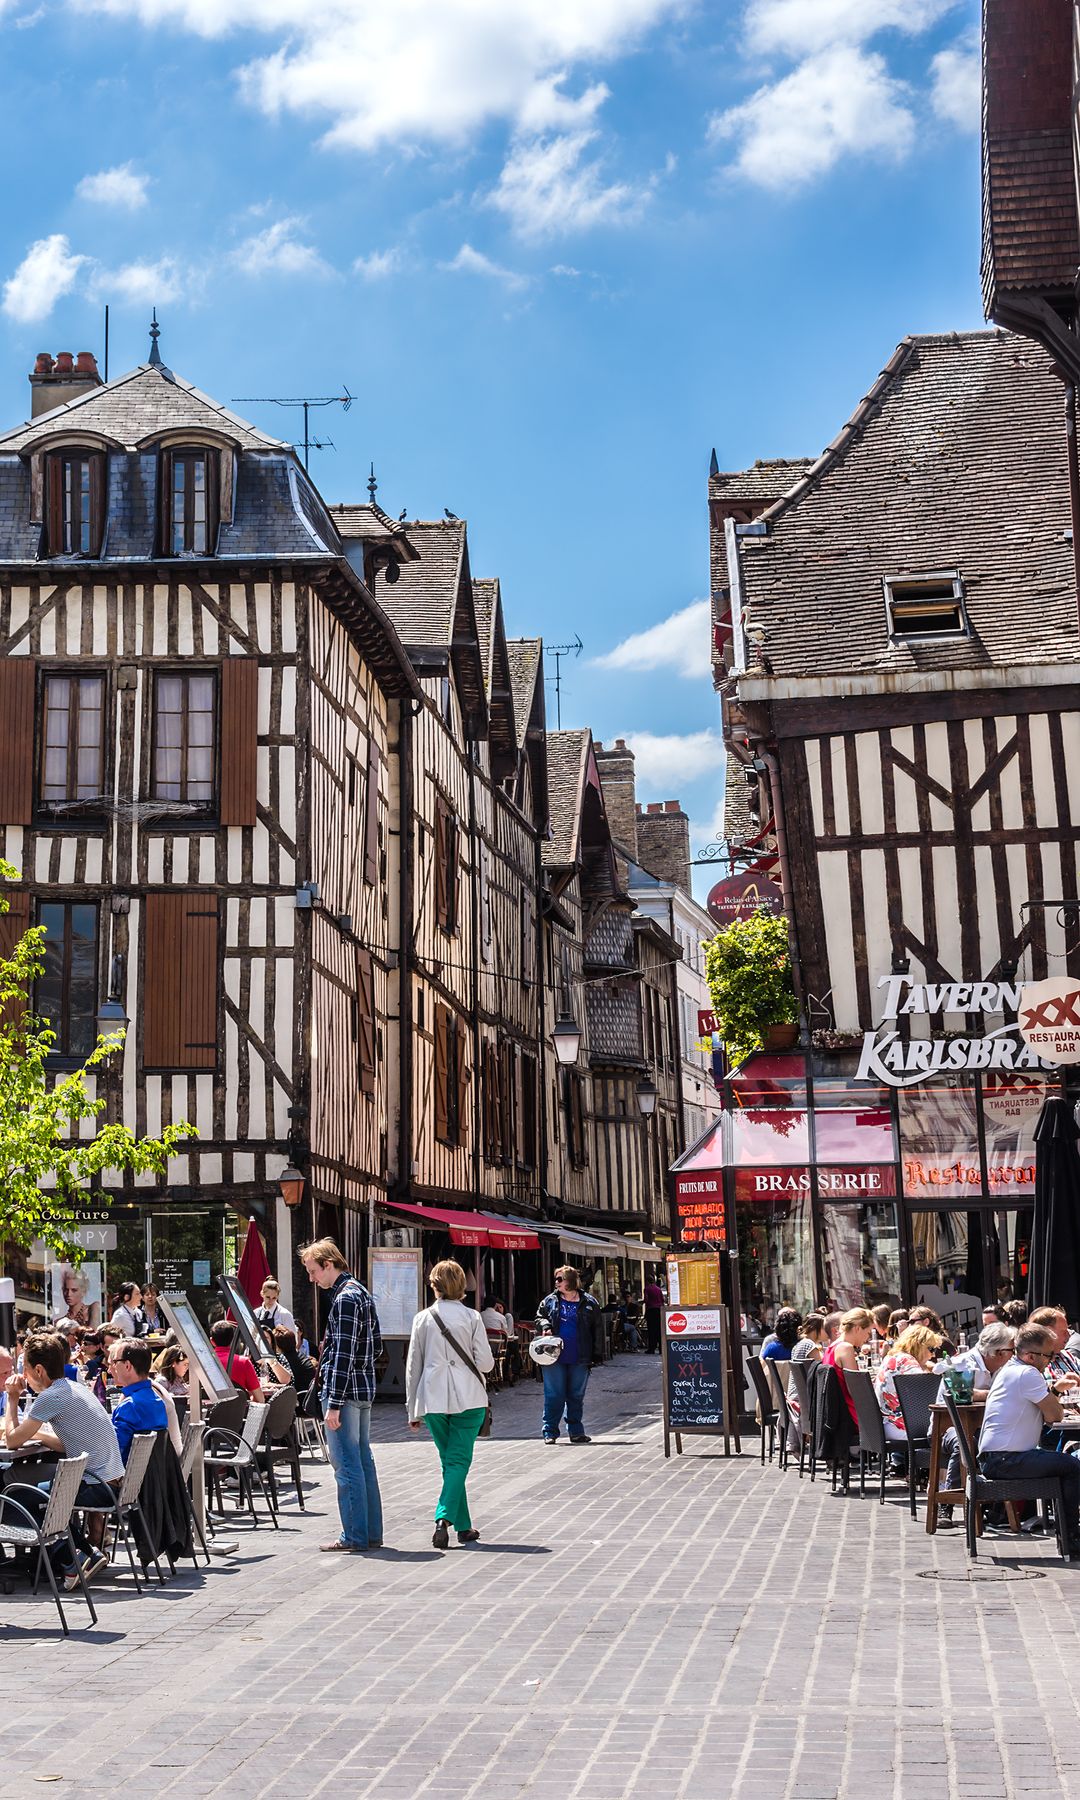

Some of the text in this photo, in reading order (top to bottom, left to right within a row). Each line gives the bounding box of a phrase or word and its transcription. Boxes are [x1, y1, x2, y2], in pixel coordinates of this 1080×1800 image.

[877, 975, 1040, 1020] TAVERN
[1021, 990, 1080, 1031] XX
[1030, 1031, 1080, 1043] RESTAURA
[1055, 1043, 1076, 1053] BAR
[679, 1181, 718, 1194] FRUITS DE MER
[755, 1174, 881, 1191] BRASSERIE
[41, 1210, 109, 1220] Coifure
[678, 1203, 725, 1216] RESTAURATIO
[43, 1231, 108, 1244] ARPY
[678, 1363, 710, 1377] XXL
